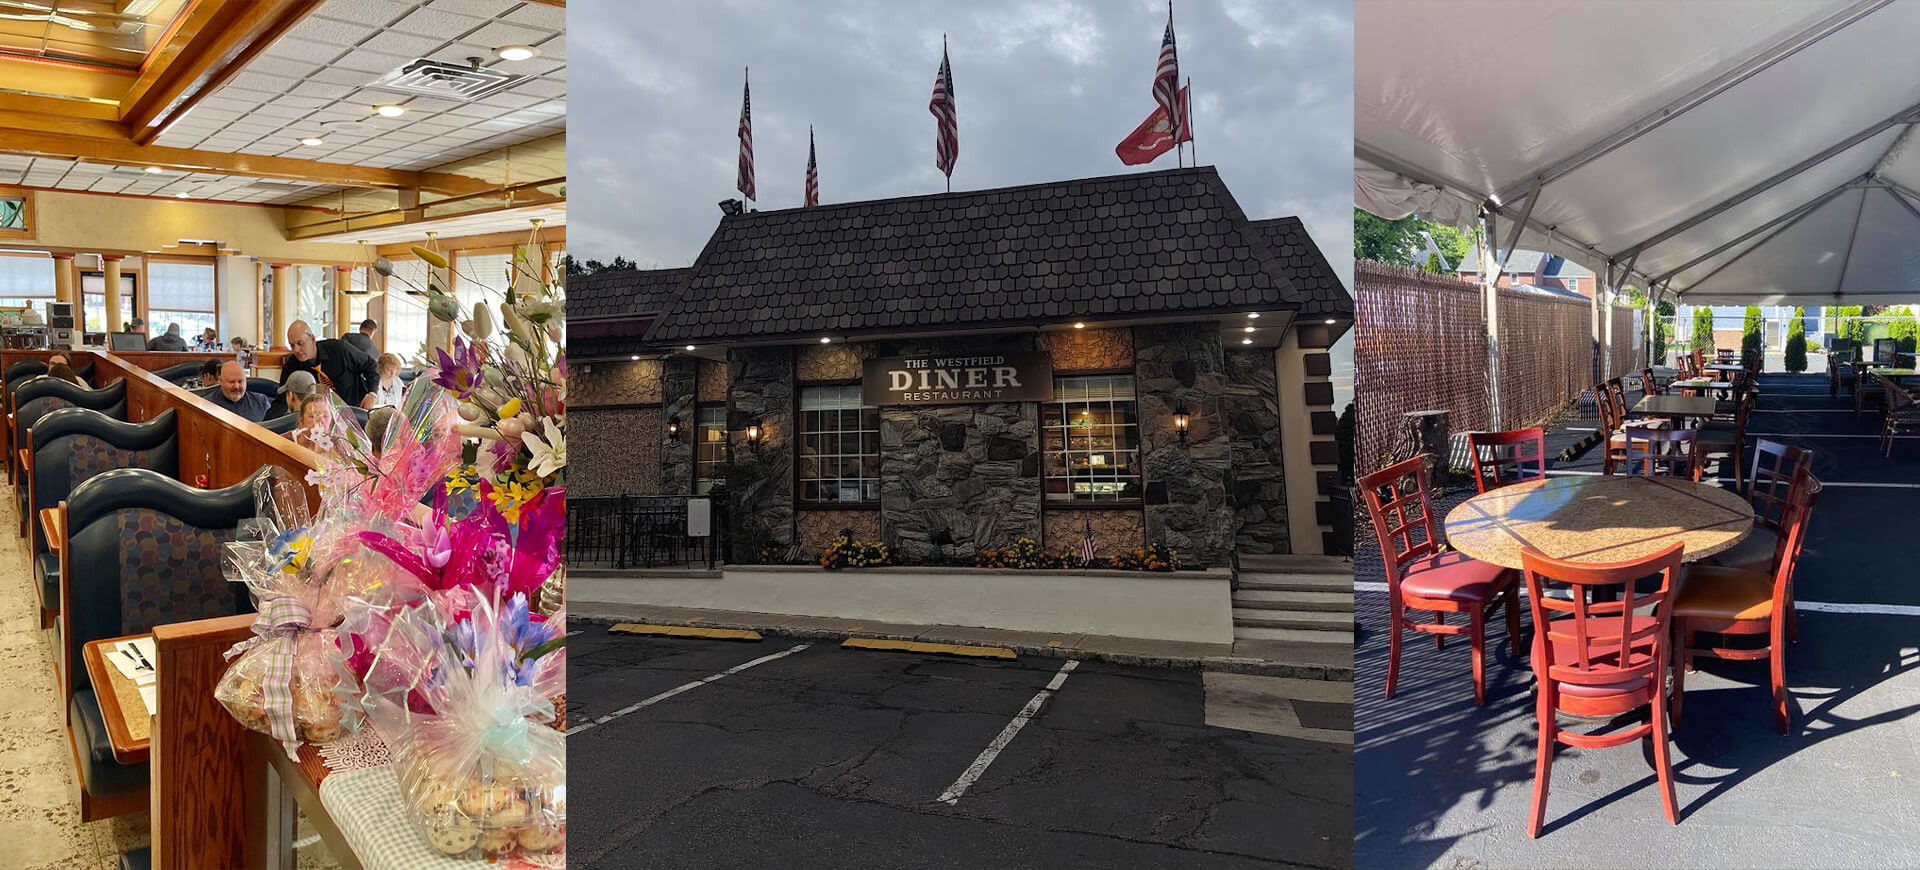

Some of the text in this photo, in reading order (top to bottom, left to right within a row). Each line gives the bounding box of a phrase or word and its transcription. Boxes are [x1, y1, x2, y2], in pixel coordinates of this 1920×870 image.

[904, 356, 1005, 369] THE WESTFIELD
[888, 367, 1022, 391] DINER
[904, 390, 1002, 401] RESTAURANT
